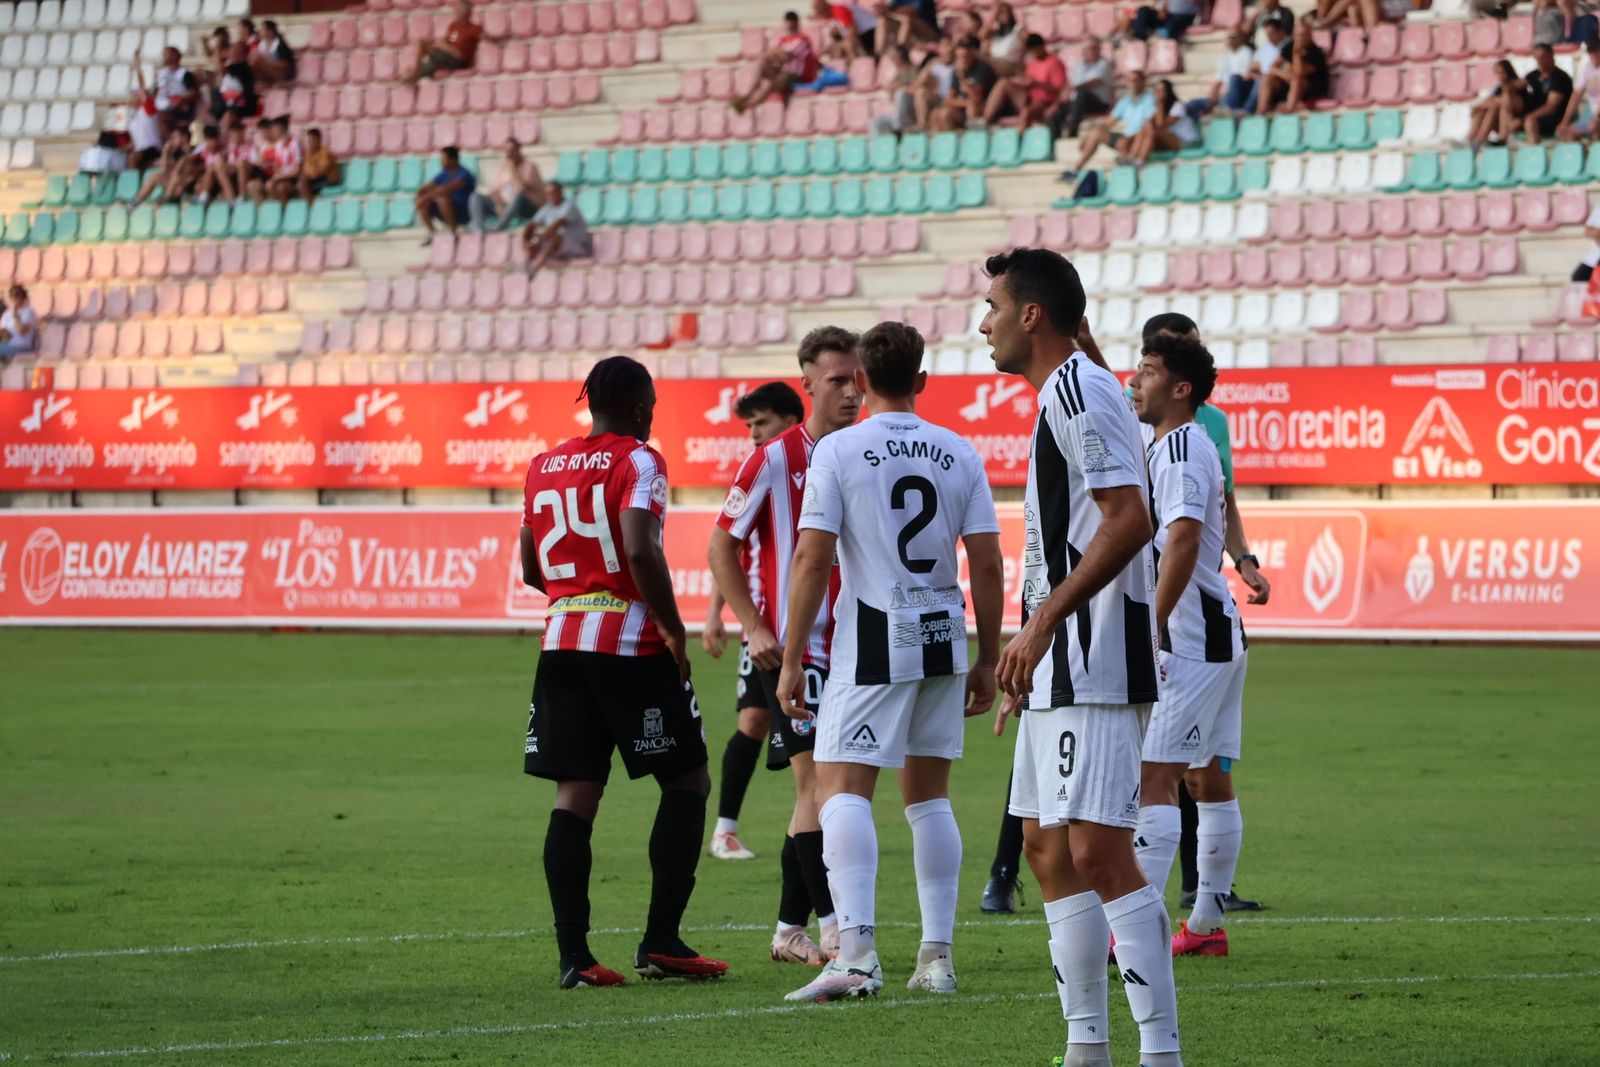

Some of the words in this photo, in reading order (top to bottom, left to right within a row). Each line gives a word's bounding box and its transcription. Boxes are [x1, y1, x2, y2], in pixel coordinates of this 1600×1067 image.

[1496, 368, 1598, 409] Clínica
[1228, 405, 1386, 451] utorecicla
[541, 455, 566, 474] LUIS
[567, 452, 612, 471] RIVAS
[864, 440, 955, 471] S.CAMUS
[1421, 445, 1483, 478] Viso
[533, 483, 621, 581] 24
[890, 475, 938, 574] 2
[63, 541, 131, 577] ELOY
[133, 532, 248, 577] ÁLVAREZ
[1440, 538, 1583, 580] VERSUS
[1451, 582, 1565, 604] E-LEARNING
[633, 736, 677, 752] ZAMORA
[1059, 731, 1076, 778] 9
